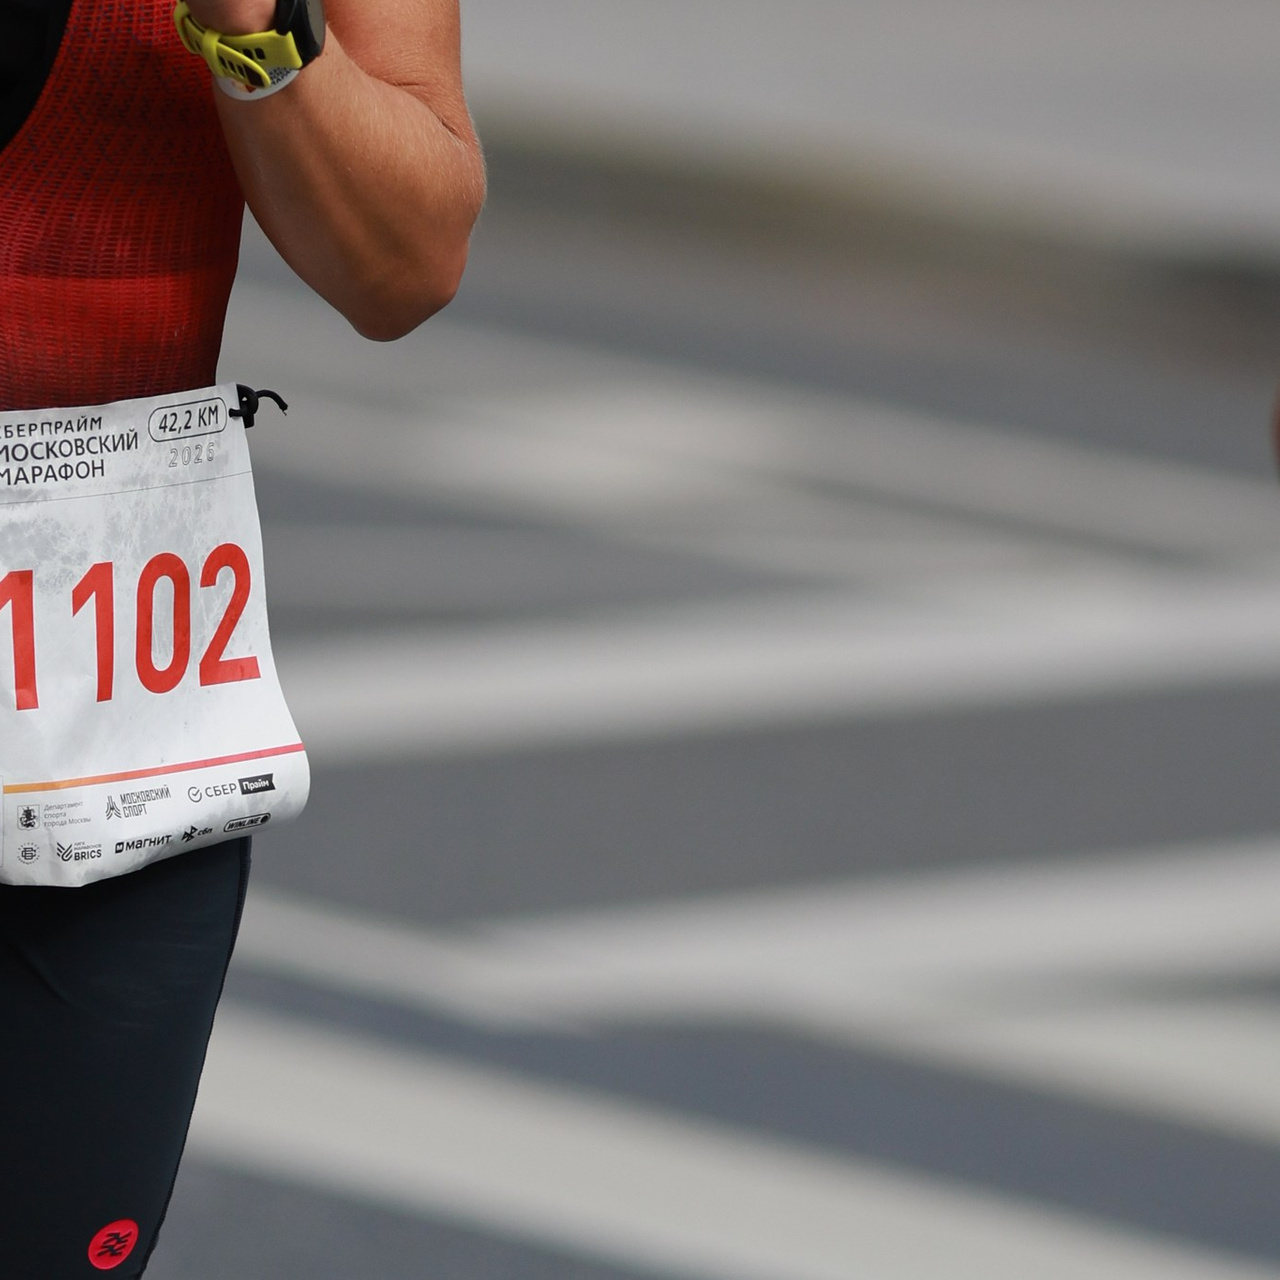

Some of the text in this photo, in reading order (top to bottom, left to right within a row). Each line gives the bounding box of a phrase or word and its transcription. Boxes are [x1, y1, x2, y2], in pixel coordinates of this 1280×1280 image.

[158, 405, 219, 434] 42,2 КМ
[169, 441, 215, 468] 2026
[120, 784, 171, 805] МОСКОВСКИЙ
[205, 778, 269, 798] СБЕР Прайм
[123, 803, 147, 818] СПОРТ
[74, 849, 102, 861] BRICS
